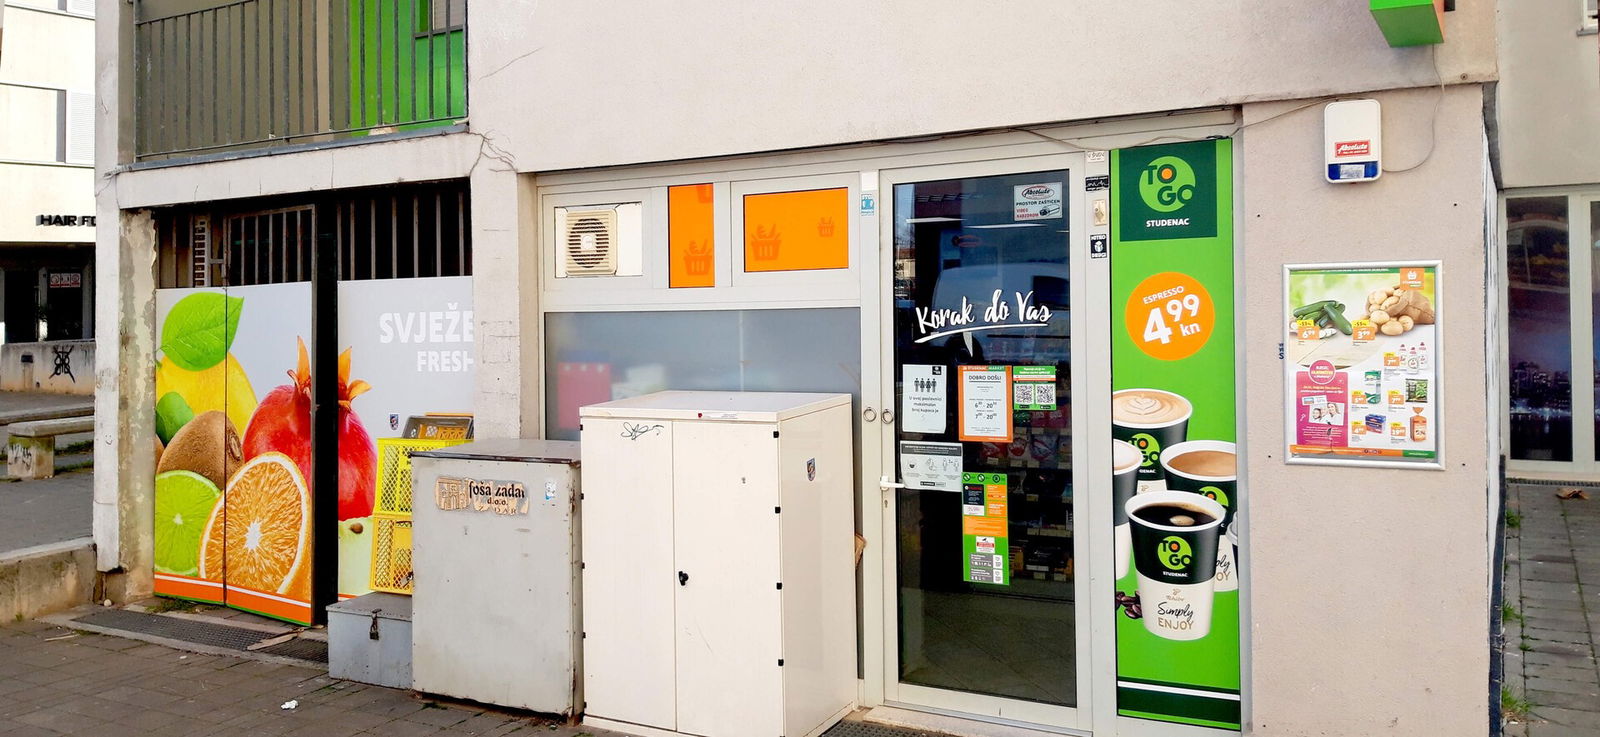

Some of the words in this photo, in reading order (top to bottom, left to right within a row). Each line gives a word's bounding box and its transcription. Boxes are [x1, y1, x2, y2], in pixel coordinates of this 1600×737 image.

[1144, 164, 1177, 185] TO
[1157, 184, 1196, 206] GO
[36, 214, 77, 226] HAIR
[1146, 218, 1190, 227] STUDENAC
[1143, 285, 1185, 305] ESPRESSO
[915, 296, 975, 334] Korak
[984, 289, 1010, 323] do
[1015, 290, 1053, 322] Vas
[379, 302, 474, 343] SVJEŽE
[1179, 322, 1201, 338] kn
[487, 496, 508, 505] d.o.o.
[1161, 540, 1181, 553] TO
[1169, 554, 1193, 567] GO
[1157, 601, 1194, 622] Simply
[1157, 617, 1194, 630] ENJOY
